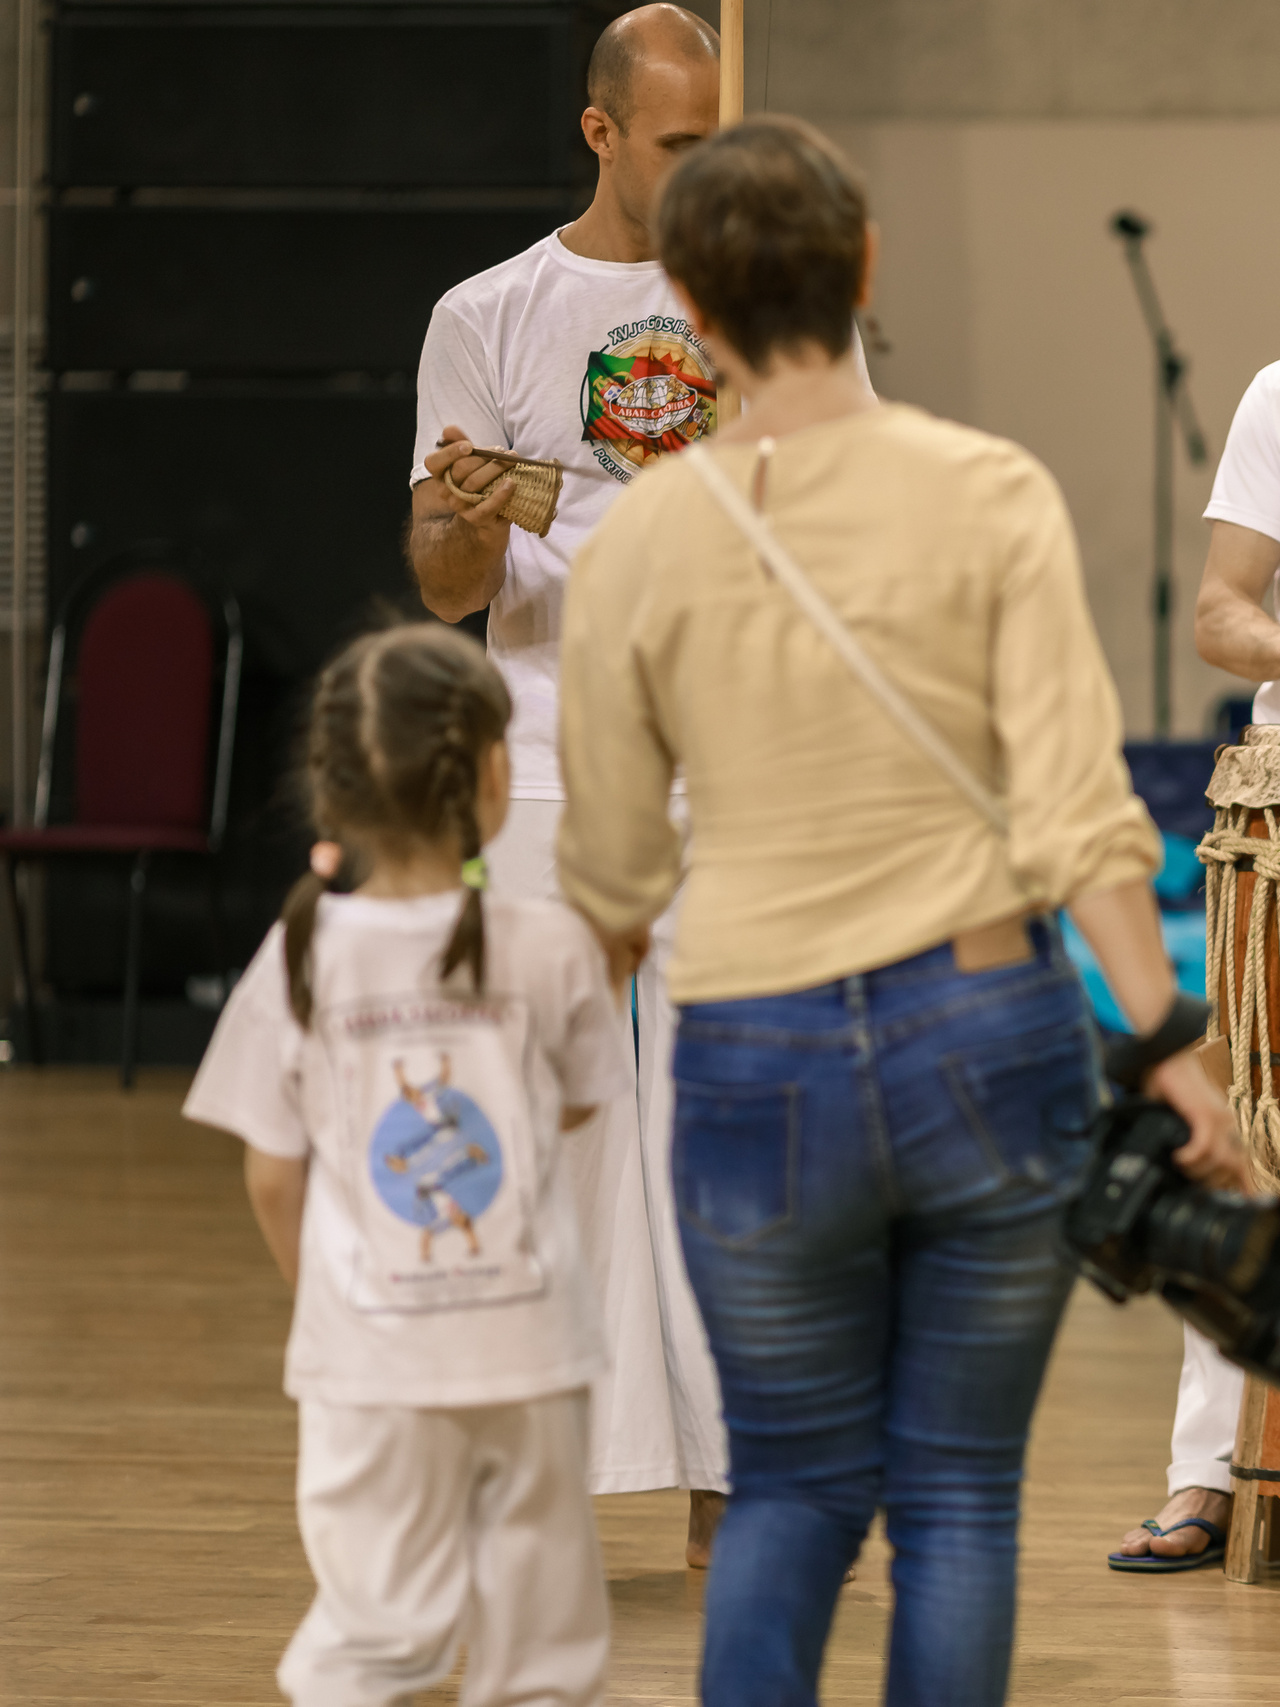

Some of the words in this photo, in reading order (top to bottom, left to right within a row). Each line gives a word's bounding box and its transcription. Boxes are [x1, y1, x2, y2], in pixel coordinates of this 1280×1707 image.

[608, 324, 629, 346] XV
[629, 315, 674, 337] JOGOS
[593, 448, 633, 485] PORTUG
